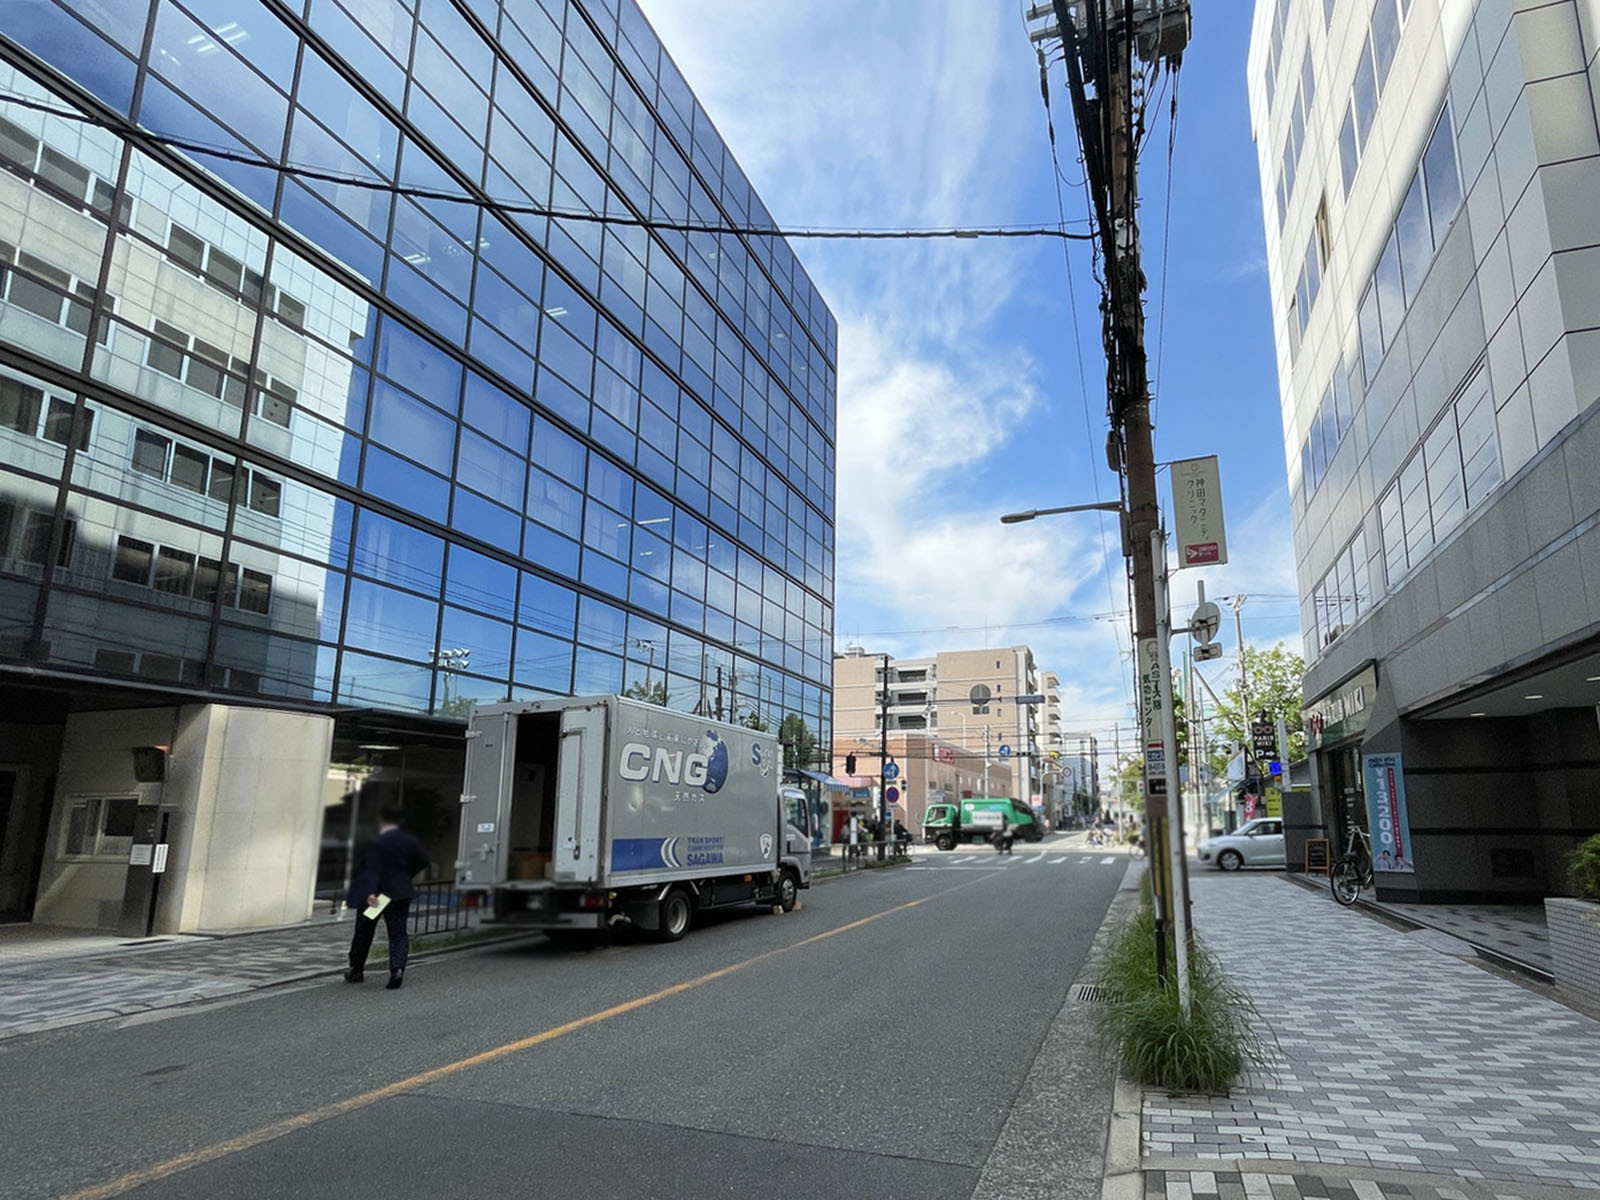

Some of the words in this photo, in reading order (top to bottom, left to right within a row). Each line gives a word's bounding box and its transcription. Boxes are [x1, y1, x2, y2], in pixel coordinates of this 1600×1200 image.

[1186, 479, 1198, 525] クリニック
[619, 742, 710, 787] CNG
[1255, 749, 1265, 759] P
[687, 852, 724, 866] SAGAWA
